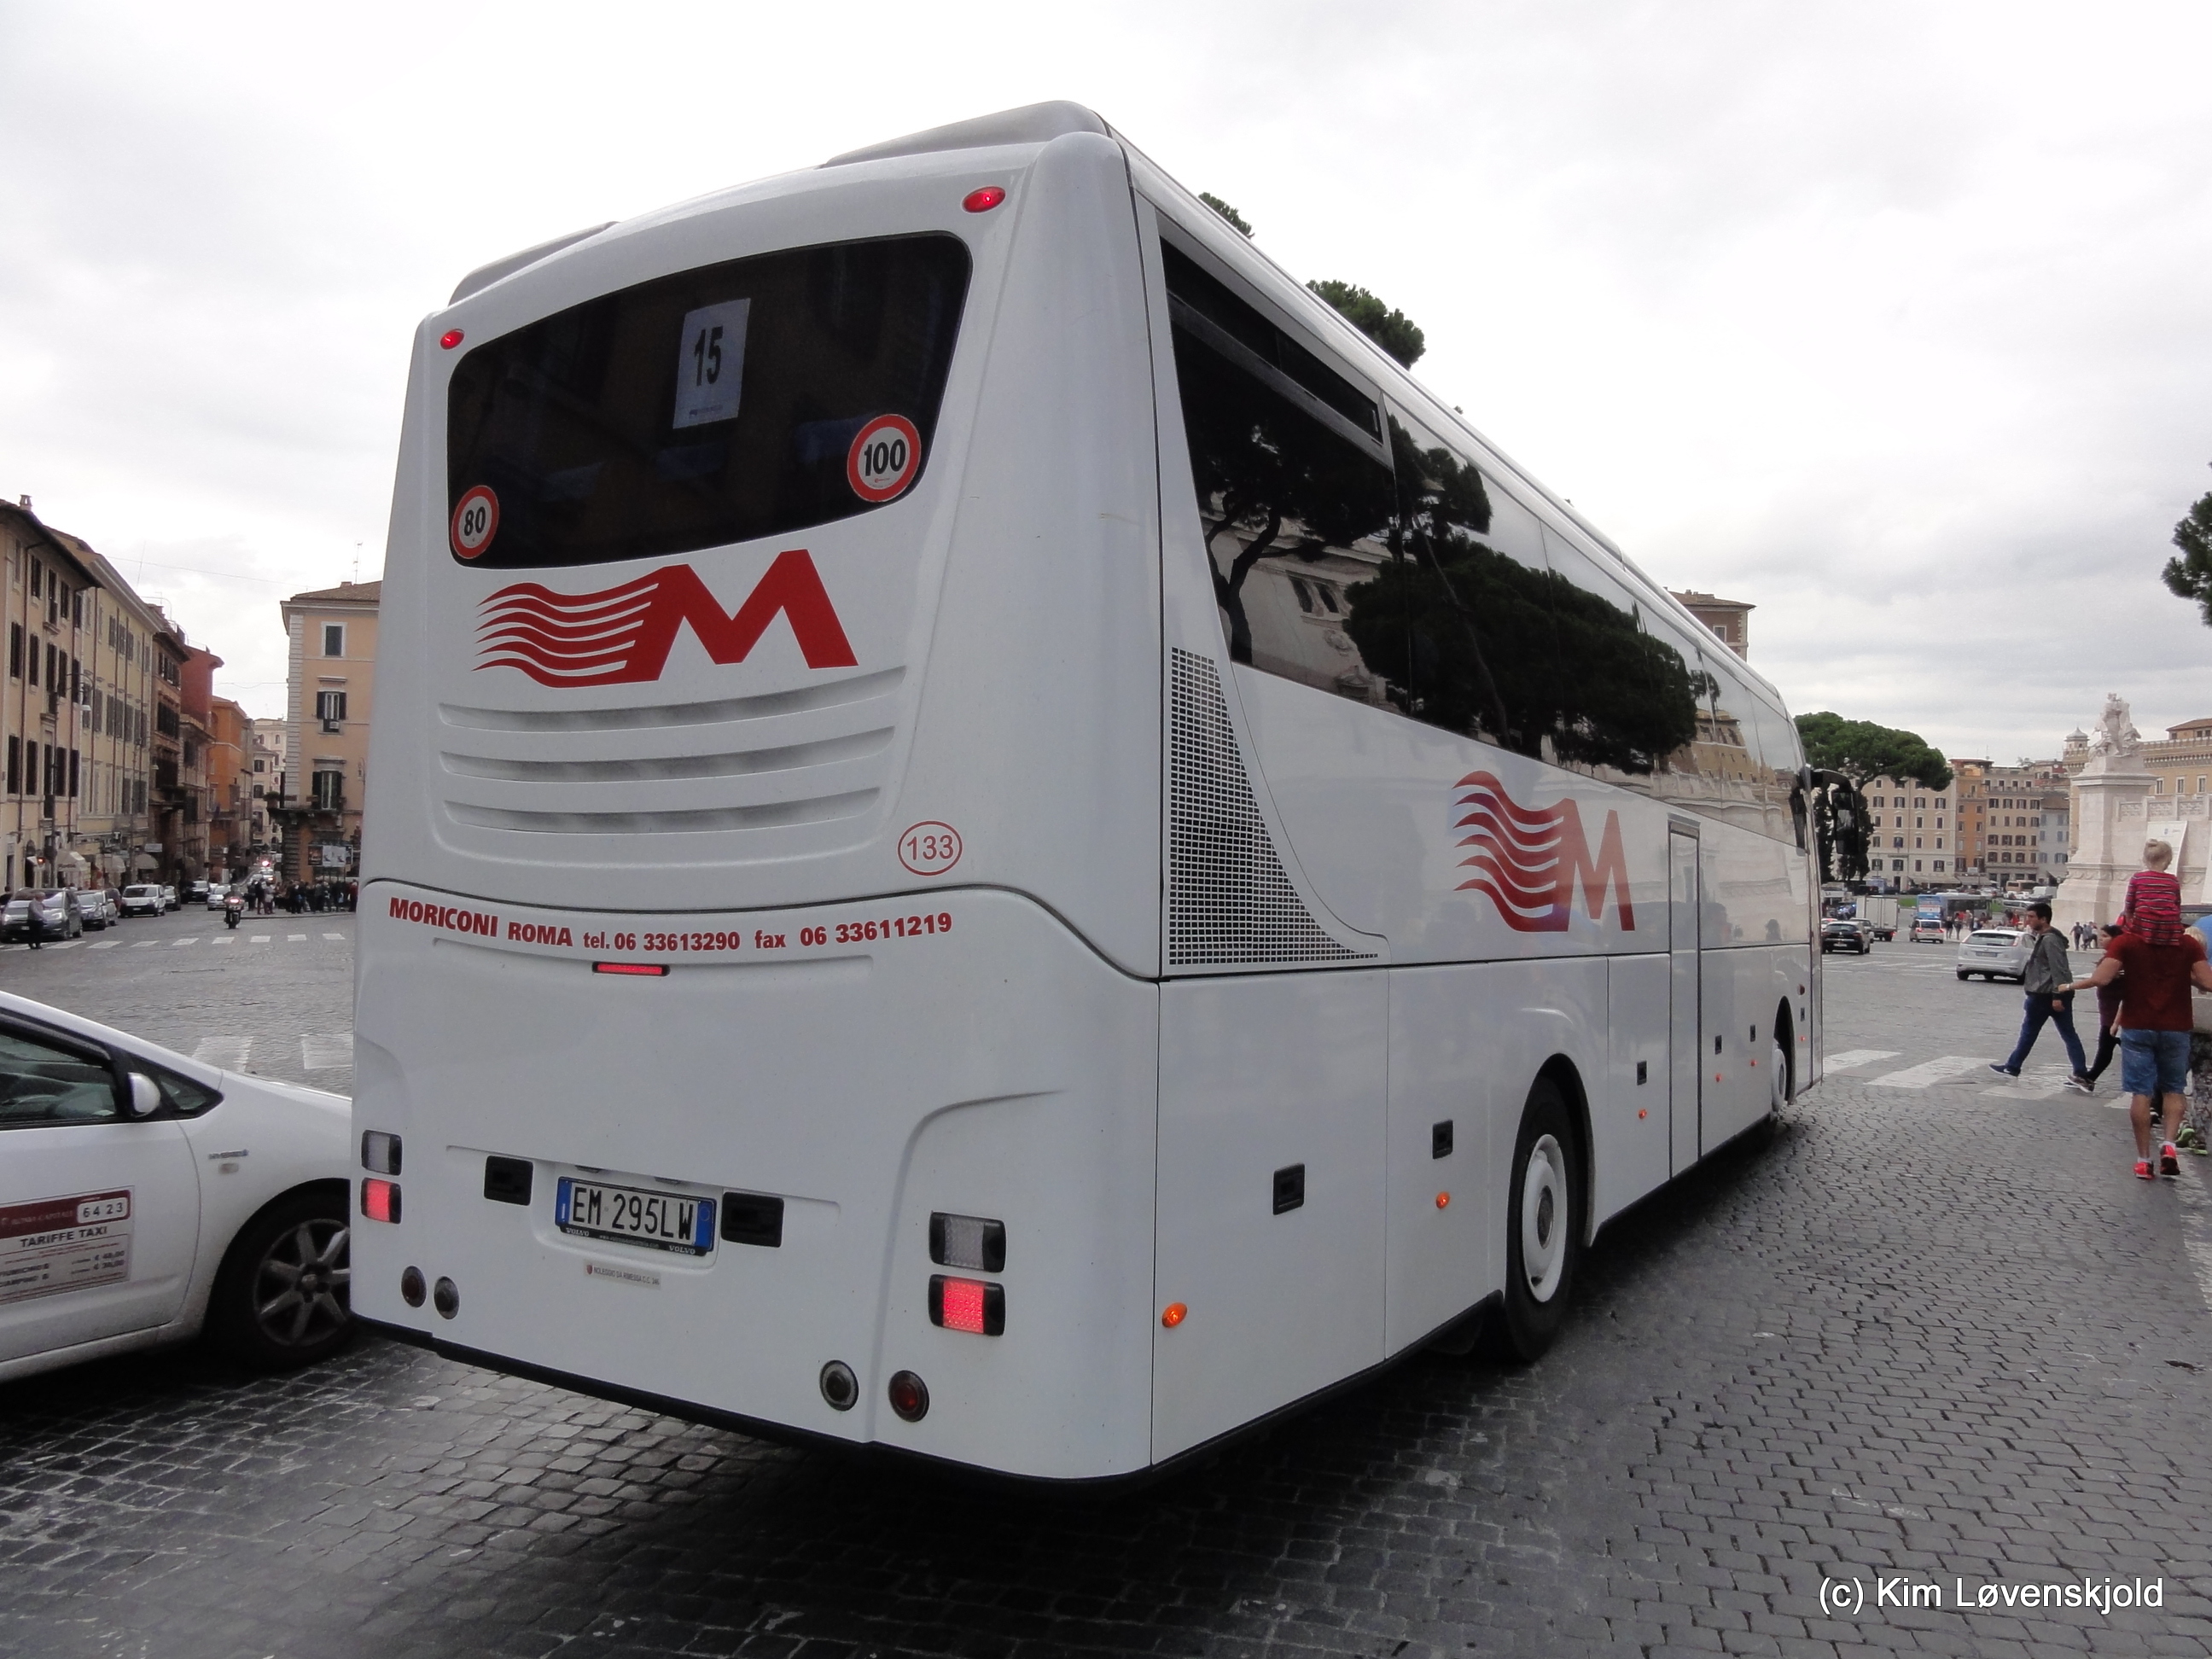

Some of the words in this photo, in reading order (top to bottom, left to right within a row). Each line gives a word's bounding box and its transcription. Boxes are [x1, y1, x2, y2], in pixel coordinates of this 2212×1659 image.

[694, 325, 724, 387] 15
[864, 439, 906, 476] 100
[463, 506, 486, 537] 80
[906, 835, 954, 860] 133
[389, 897, 498, 937] MORICONI
[508, 922, 573, 946] ROMA
[583, 931, 610, 949] tel.
[614, 933, 637, 951] 06
[643, 931, 741, 952] 33613290
[754, 930, 786, 948] fax
[800, 926, 827, 946] 06
[835, 912, 952, 943] 33611219
[573, 1187, 602, 1225] EM
[20, 1231, 74, 1247] TARIFFE
[79, 1225, 108, 1238] TAXI
[566, 1227, 590, 1237] VOLVO
[668, 1245, 696, 1254] VOLVO
